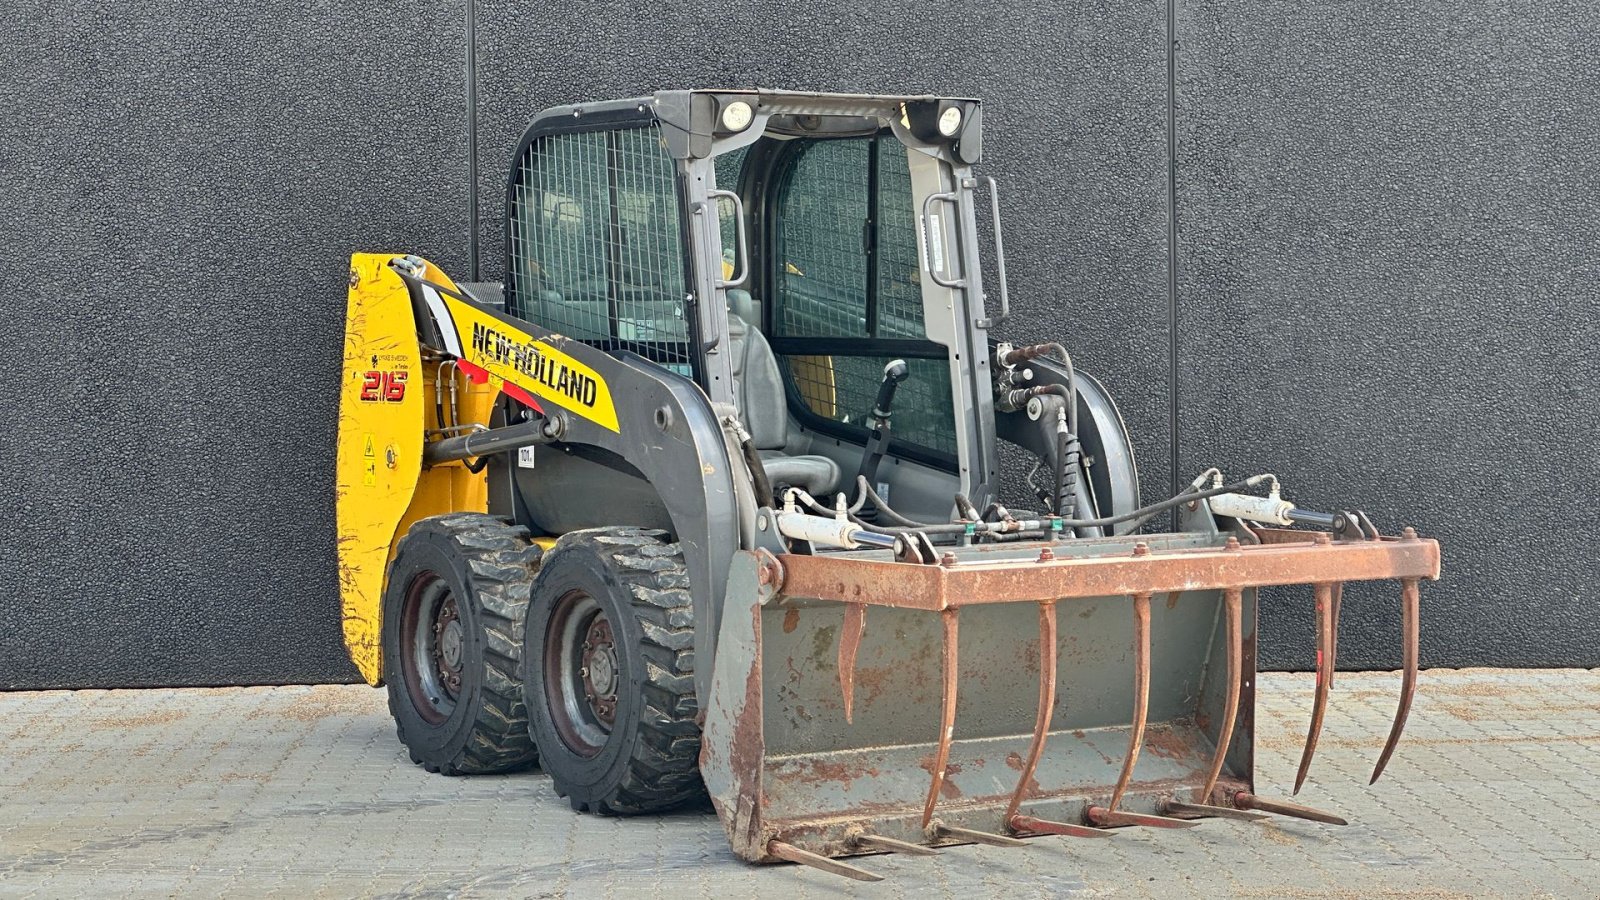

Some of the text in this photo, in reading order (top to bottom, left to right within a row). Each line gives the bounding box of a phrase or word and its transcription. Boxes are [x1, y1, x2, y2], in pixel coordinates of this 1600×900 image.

[360, 370, 408, 402] 216
[472, 321, 597, 408] NEW HOLLAND
